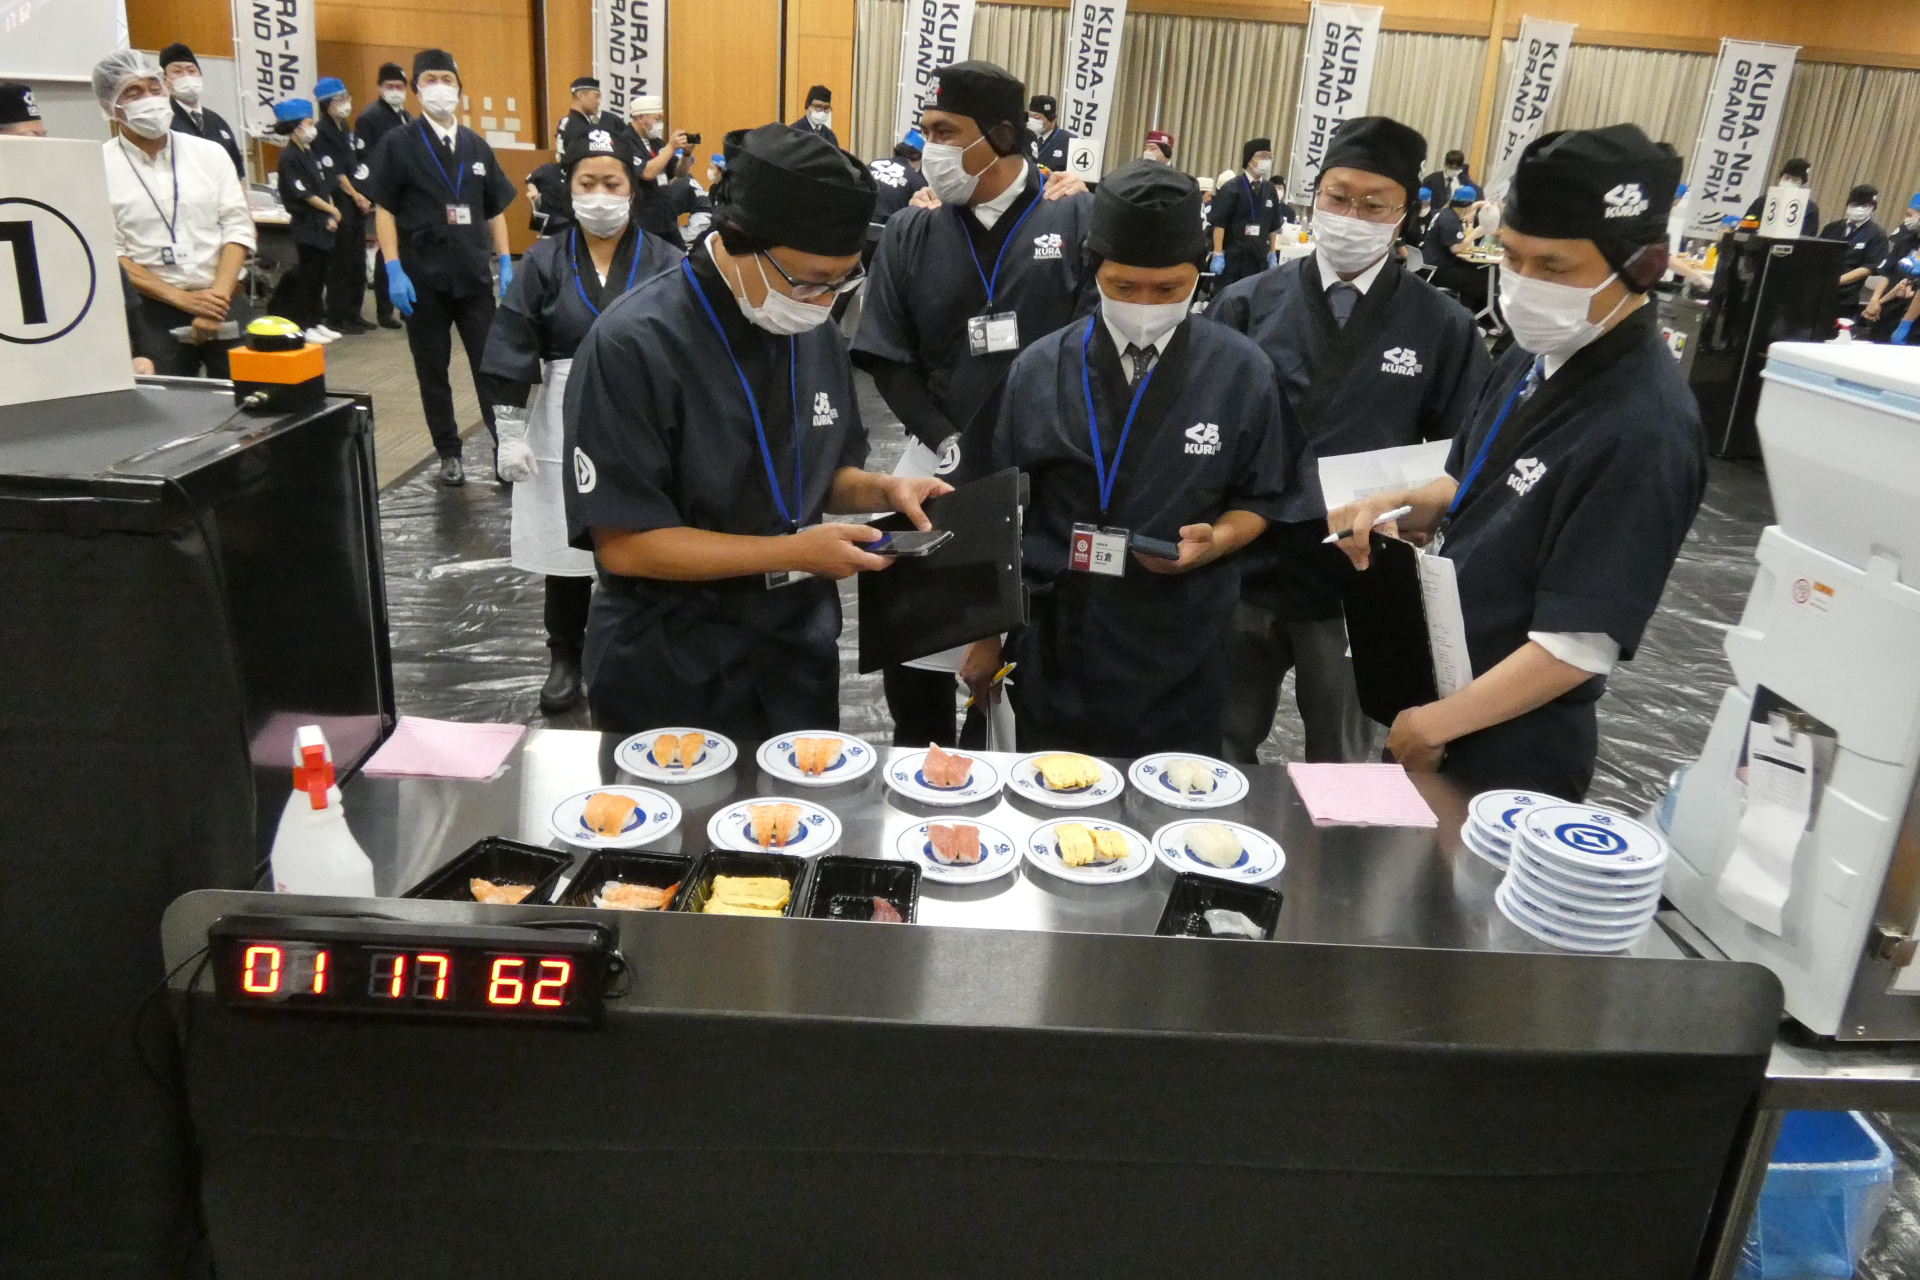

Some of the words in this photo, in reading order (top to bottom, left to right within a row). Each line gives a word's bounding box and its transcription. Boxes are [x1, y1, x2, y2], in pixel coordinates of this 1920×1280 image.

[916, 0, 937, 86] GRAND
[936, 3, 960, 69] KUR
[1075, 4, 1096, 91] GRAND
[1315, 22, 1341, 107] GRAND
[255, 49, 275, 107] PRIX
[1511, 38, 1541, 123] GRAND
[1718, 59, 1751, 142] GRAND
[1305, 114, 1327, 169] PRIX
[1722, 63, 1777, 203] KURA-No.1
[1702, 150, 1728, 203] PRIX
[1604, 205, 1641, 218] KURA
[0, 220, 48, 325] 1
[1035, 247, 1061, 256] KURA
[1381, 362, 1415, 376] KURA
[244, 946, 327, 994] 01
[391, 954, 449, 1000] 17
[488, 958, 571, 1006] 62
